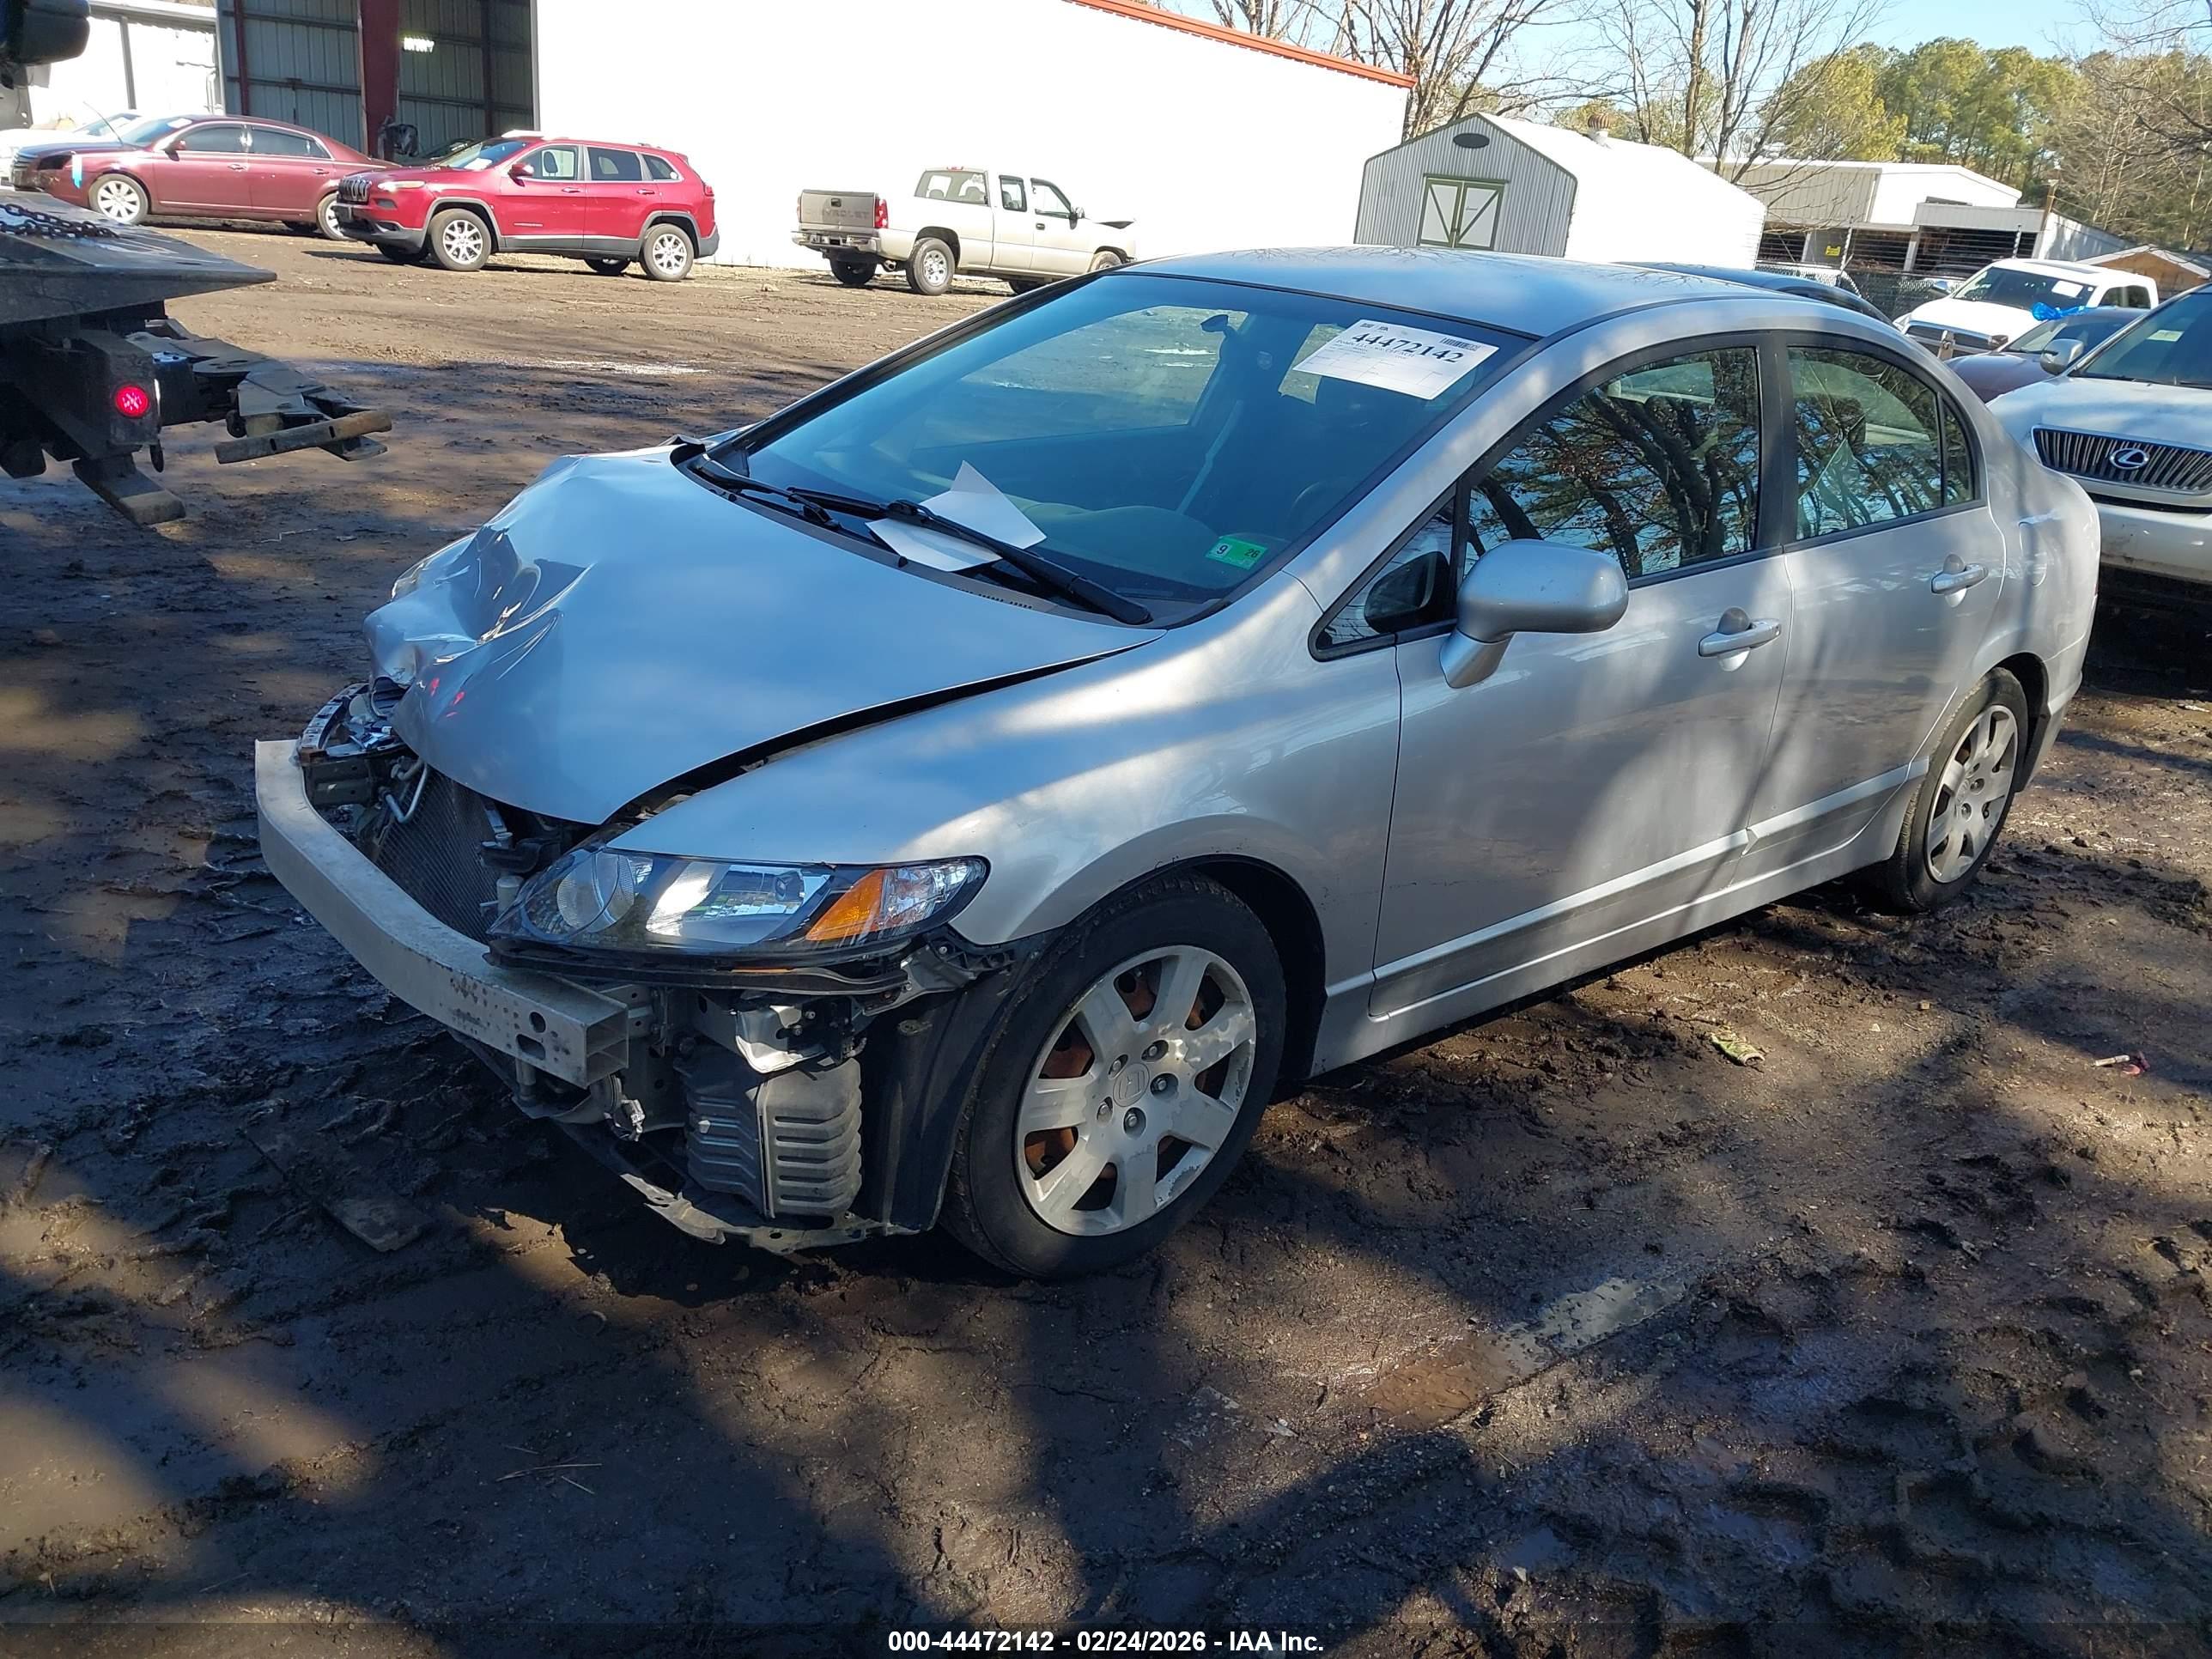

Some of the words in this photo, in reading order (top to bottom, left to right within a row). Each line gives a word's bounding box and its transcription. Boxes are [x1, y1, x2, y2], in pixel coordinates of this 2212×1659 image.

[805, 207, 870, 219] CEVROLET
[1352, 332, 1464, 363] 44472142
[1216, 544, 1229, 555] 9
[1244, 548, 1261, 558] 26
